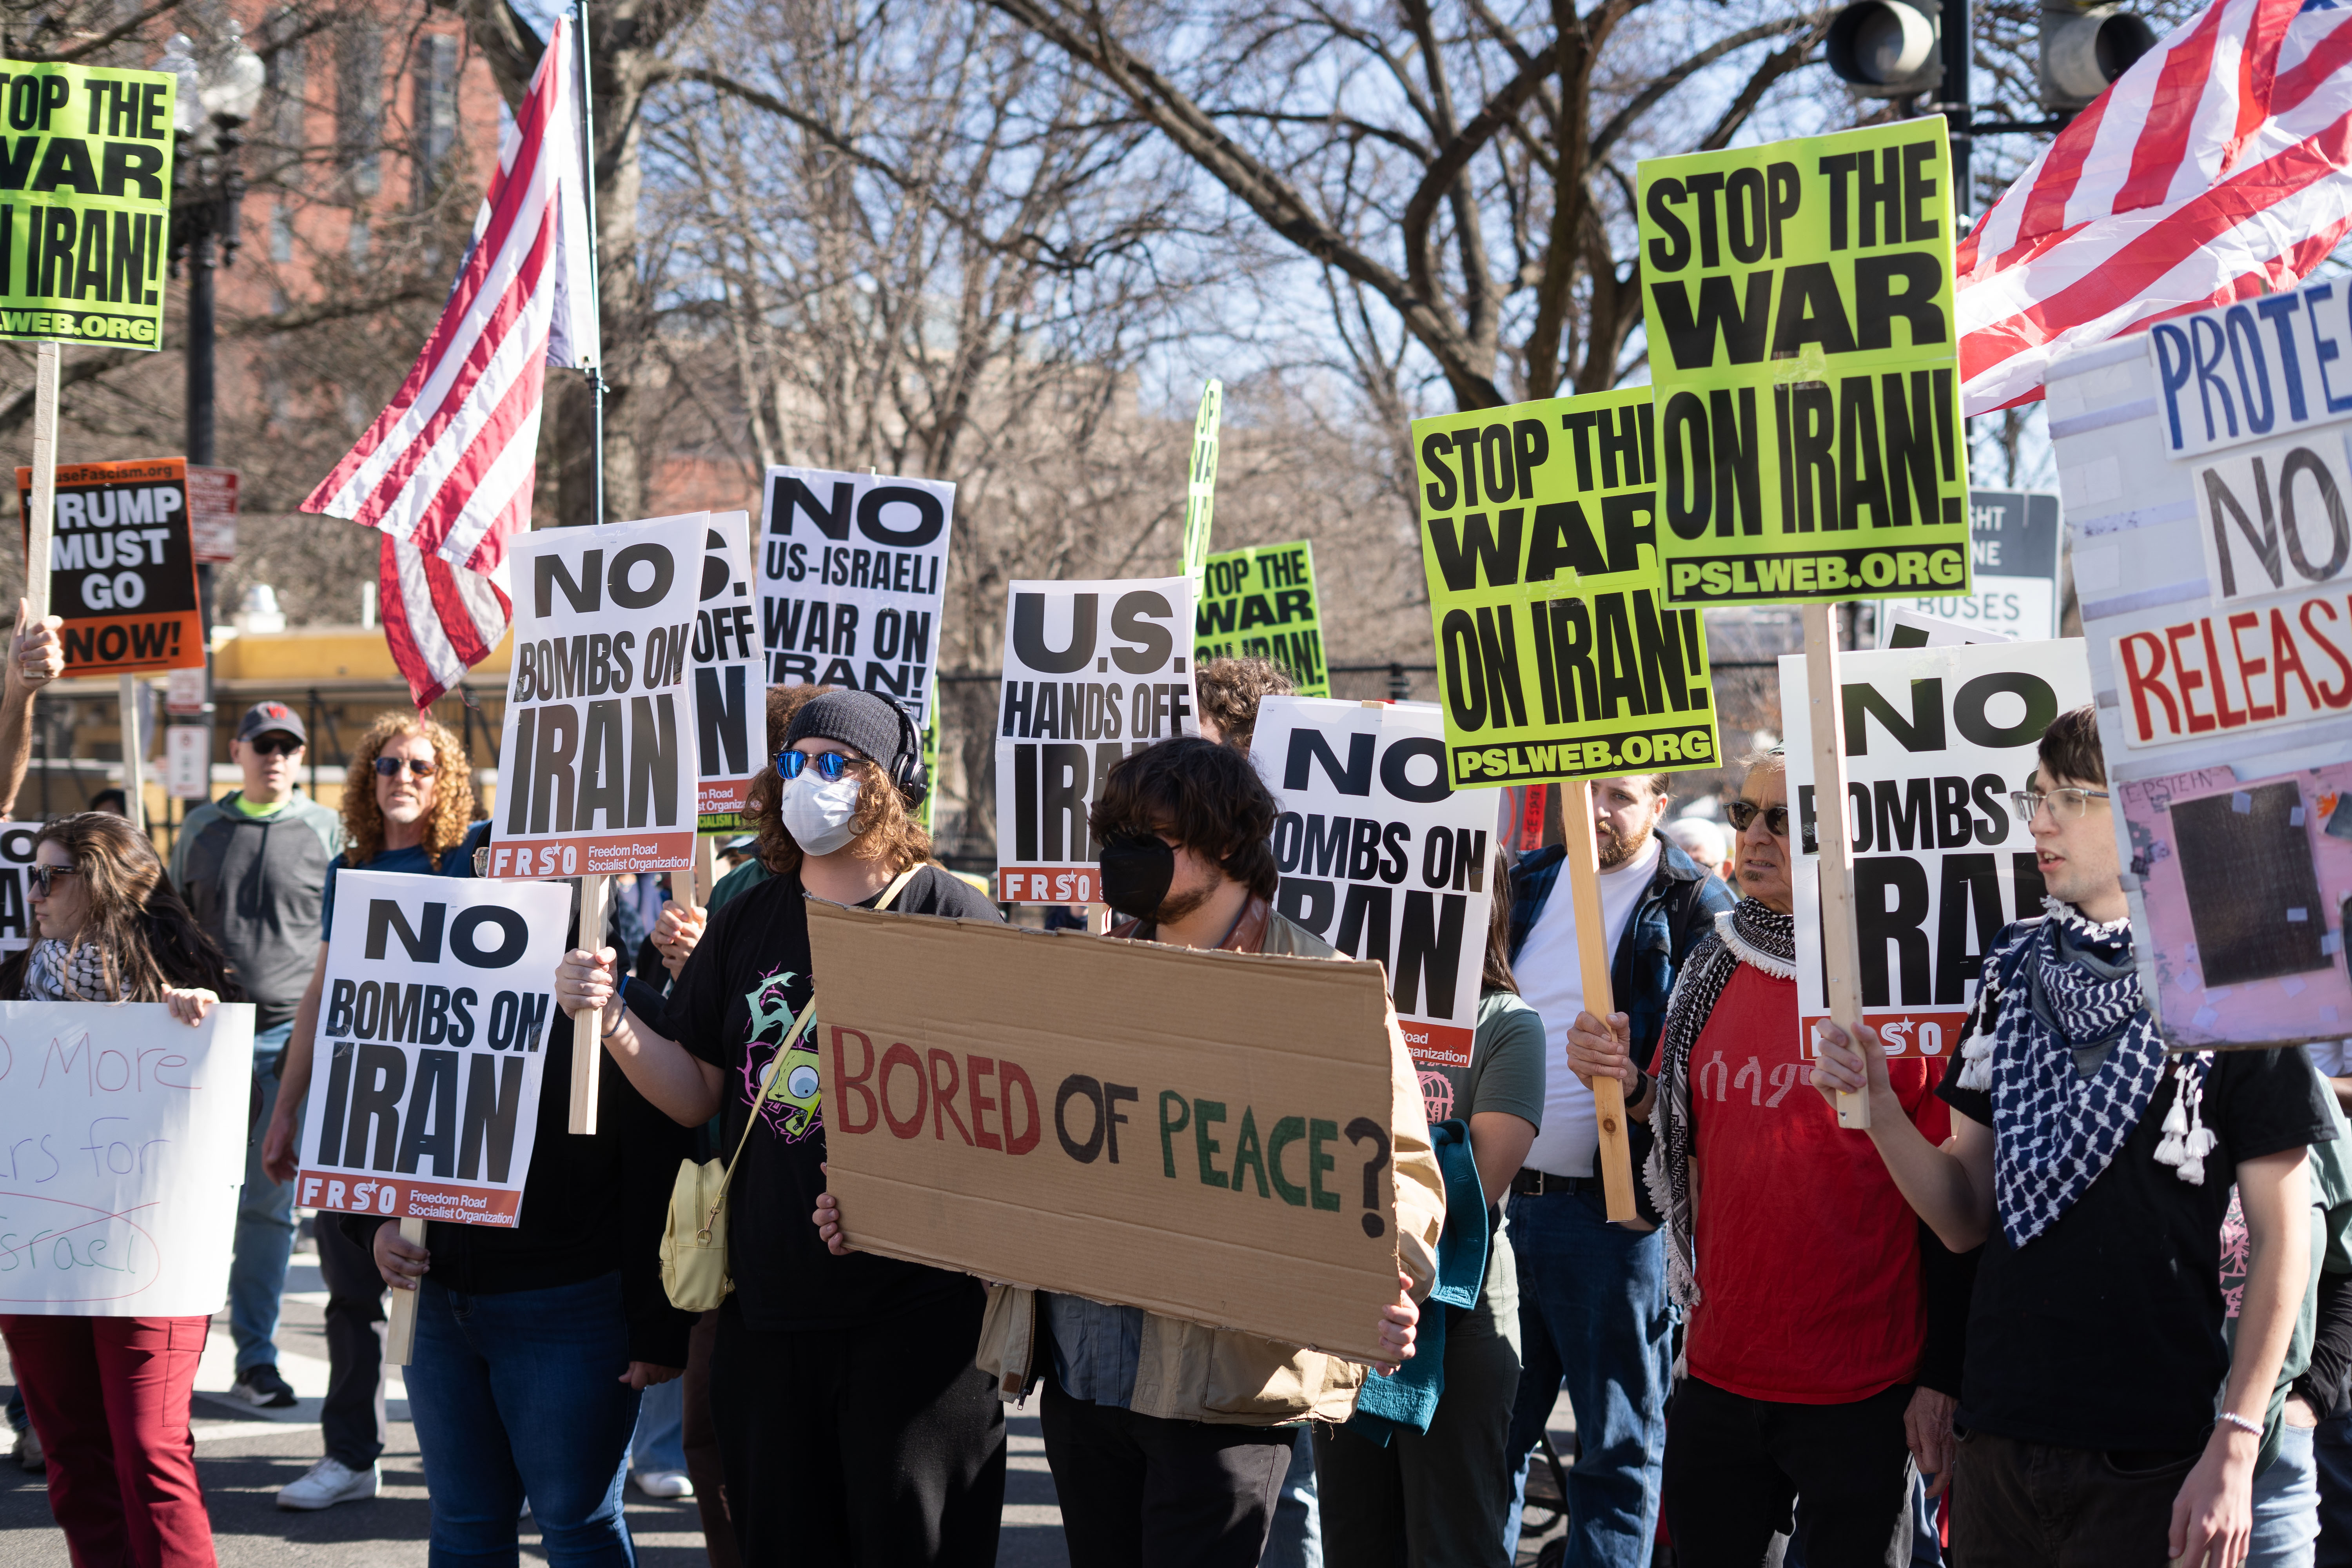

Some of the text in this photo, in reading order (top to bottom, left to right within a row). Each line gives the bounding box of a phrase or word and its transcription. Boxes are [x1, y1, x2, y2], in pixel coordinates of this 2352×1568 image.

[83, 79, 166, 140] THE
[1647, 140, 1939, 273] STOP THE
[26, 205, 162, 305] IRAN!
[0, 311, 154, 341] WEB.ORG
[1650, 251, 1947, 370] WAR
[2152, 278, 2352, 451] PROTE
[27, 466, 172, 484] useFascism.org
[1421, 419, 1549, 511] STOP
[1662, 368, 1962, 541] ON IRAN!
[770, 476, 944, 547] NO
[1427, 490, 1658, 592] WAR
[2203, 446, 2351, 598] NO
[51, 528, 170, 571] MUST
[534, 543, 675, 618] NO
[766, 542, 939, 595] US-ISRAELI
[1203, 550, 1307, 599] TOP THE
[1671, 550, 1963, 596] PSLWEB.ORG
[82, 571, 145, 610] GO
[1196, 589, 1314, 637] WAR
[65, 621, 181, 663] NOW!
[692, 606, 755, 663] OFF
[764, 596, 931, 663] WAR ON
[1013, 590, 1186, 674] U.S.
[1441, 588, 1708, 732] ON IRAN!
[513, 623, 690, 702] BOMBS ON
[2119, 593, 2352, 741] RELEAS
[1002, 681, 1123, 740] HANDS
[1131, 683, 1191, 739] OFF
[1841, 671, 2058, 756] NO
[506, 693, 677, 835] IRAN
[1283, 728, 1457, 804] NO
[1457, 730, 1711, 778] PSLWEB.ORG
[709, 788, 733, 799] Road
[1015, 742, 1154, 862] IR
[494, 841, 576, 876] FRSO
[588, 843, 657, 858] Freedom Road
[588, 856, 688, 872] Socialist Organization
[1274, 811, 1487, 893] OMBS ON
[1006, 869, 1090, 901] FRSO
[365, 899, 528, 969] NO
[325, 978, 549, 1052] BOMBS ON
[38, 1033, 202, 1096] More
[1408, 1047, 1467, 1063] ganization
[317, 1042, 525, 1183] IRAN
[831, 1025, 1391, 1238] BORED OF PEACE?
[0, 1118, 171, 1183] rs for
[301, 1178, 396, 1214] FRSO
[408, 1203, 513, 1224] Socialist Organization
[410, 1189, 486, 1209] Freedom Road
[0, 1230, 135, 1274] srael
